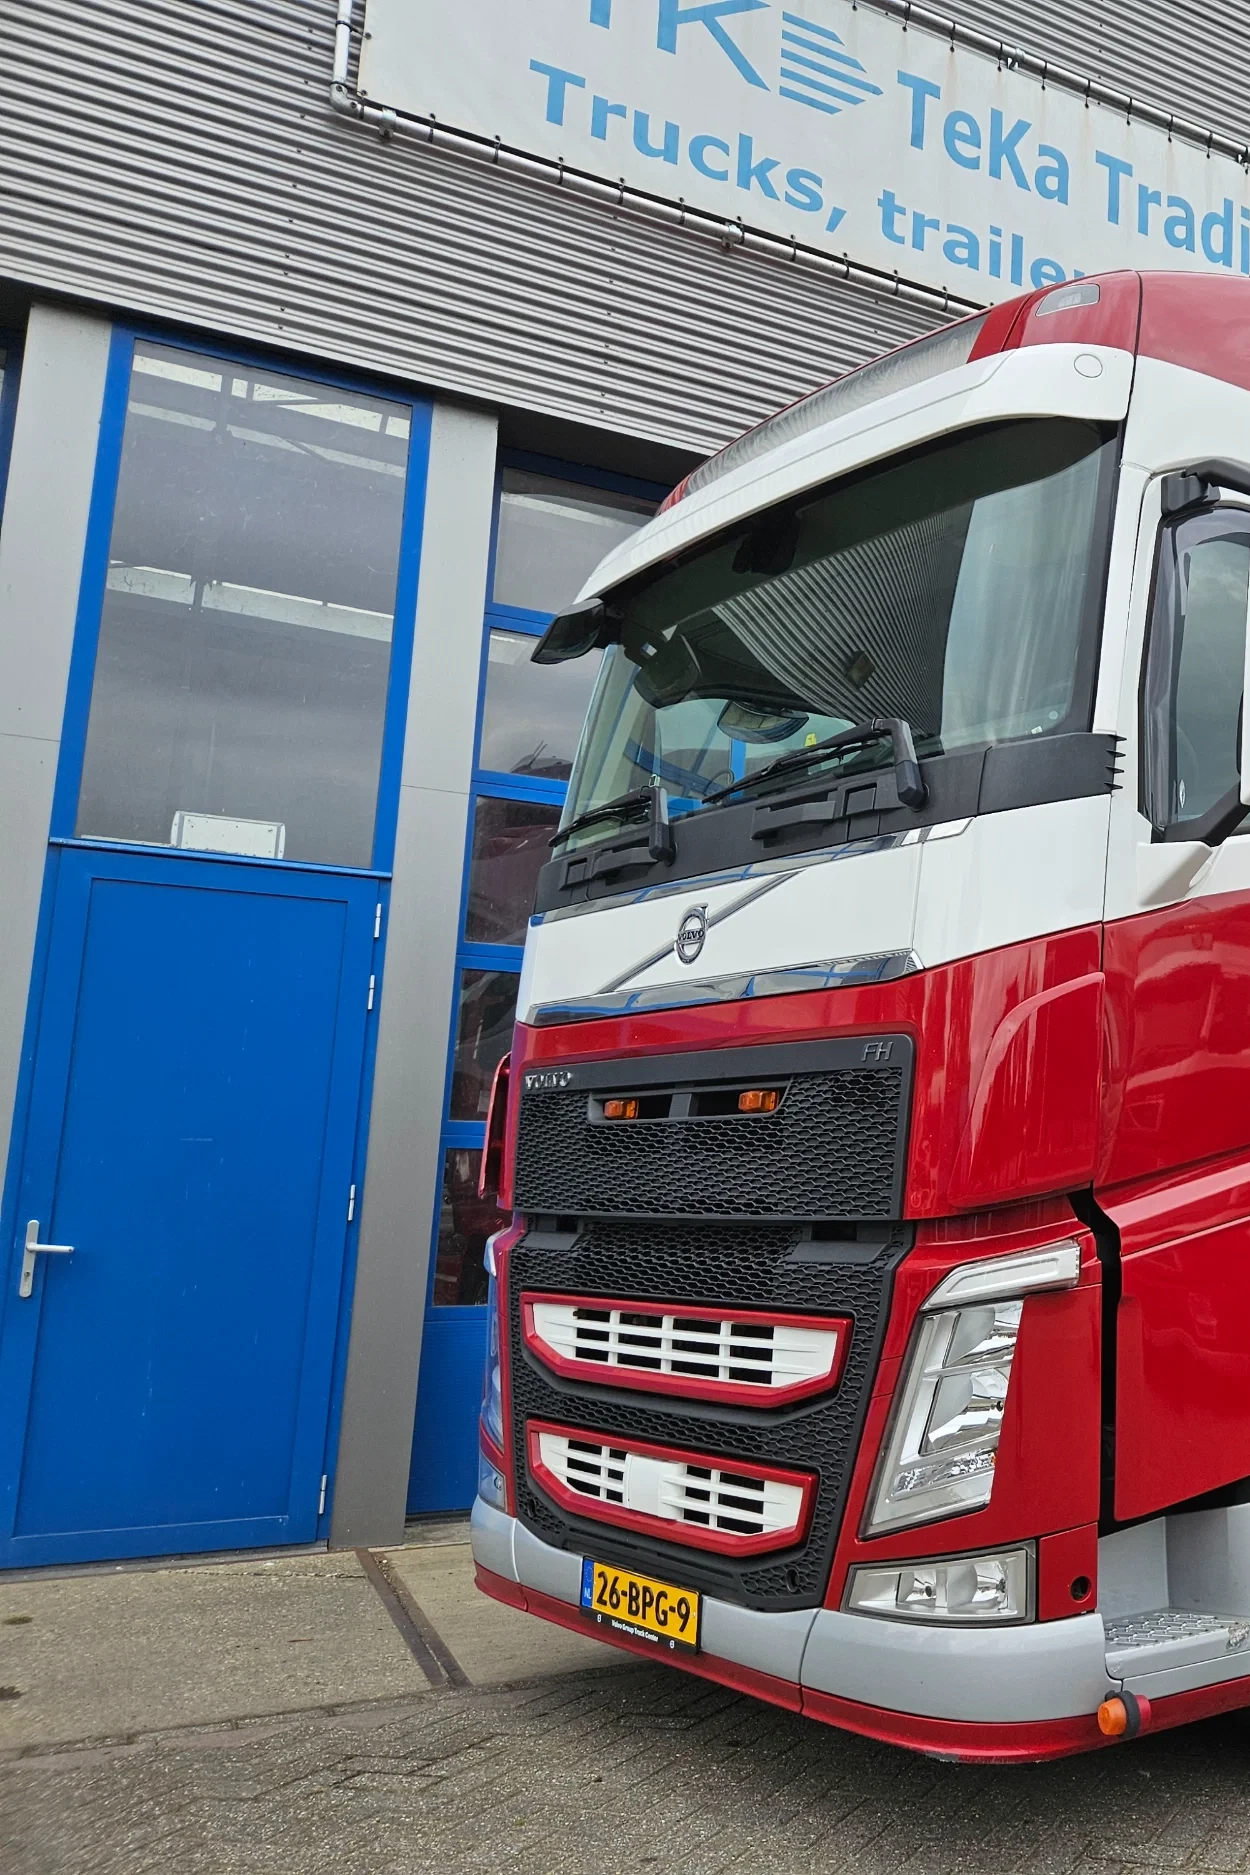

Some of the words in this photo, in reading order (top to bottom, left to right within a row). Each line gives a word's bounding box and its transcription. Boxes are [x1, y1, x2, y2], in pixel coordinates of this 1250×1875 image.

[897, 70, 1069, 205] TeKa
[529, 58, 847, 233] Trucks,
[877, 189, 1085, 289] traile
[861, 1041, 893, 1061] FH
[583, 1587, 592, 1599] NL
[596, 1570, 691, 1633] 26-BPG-9
